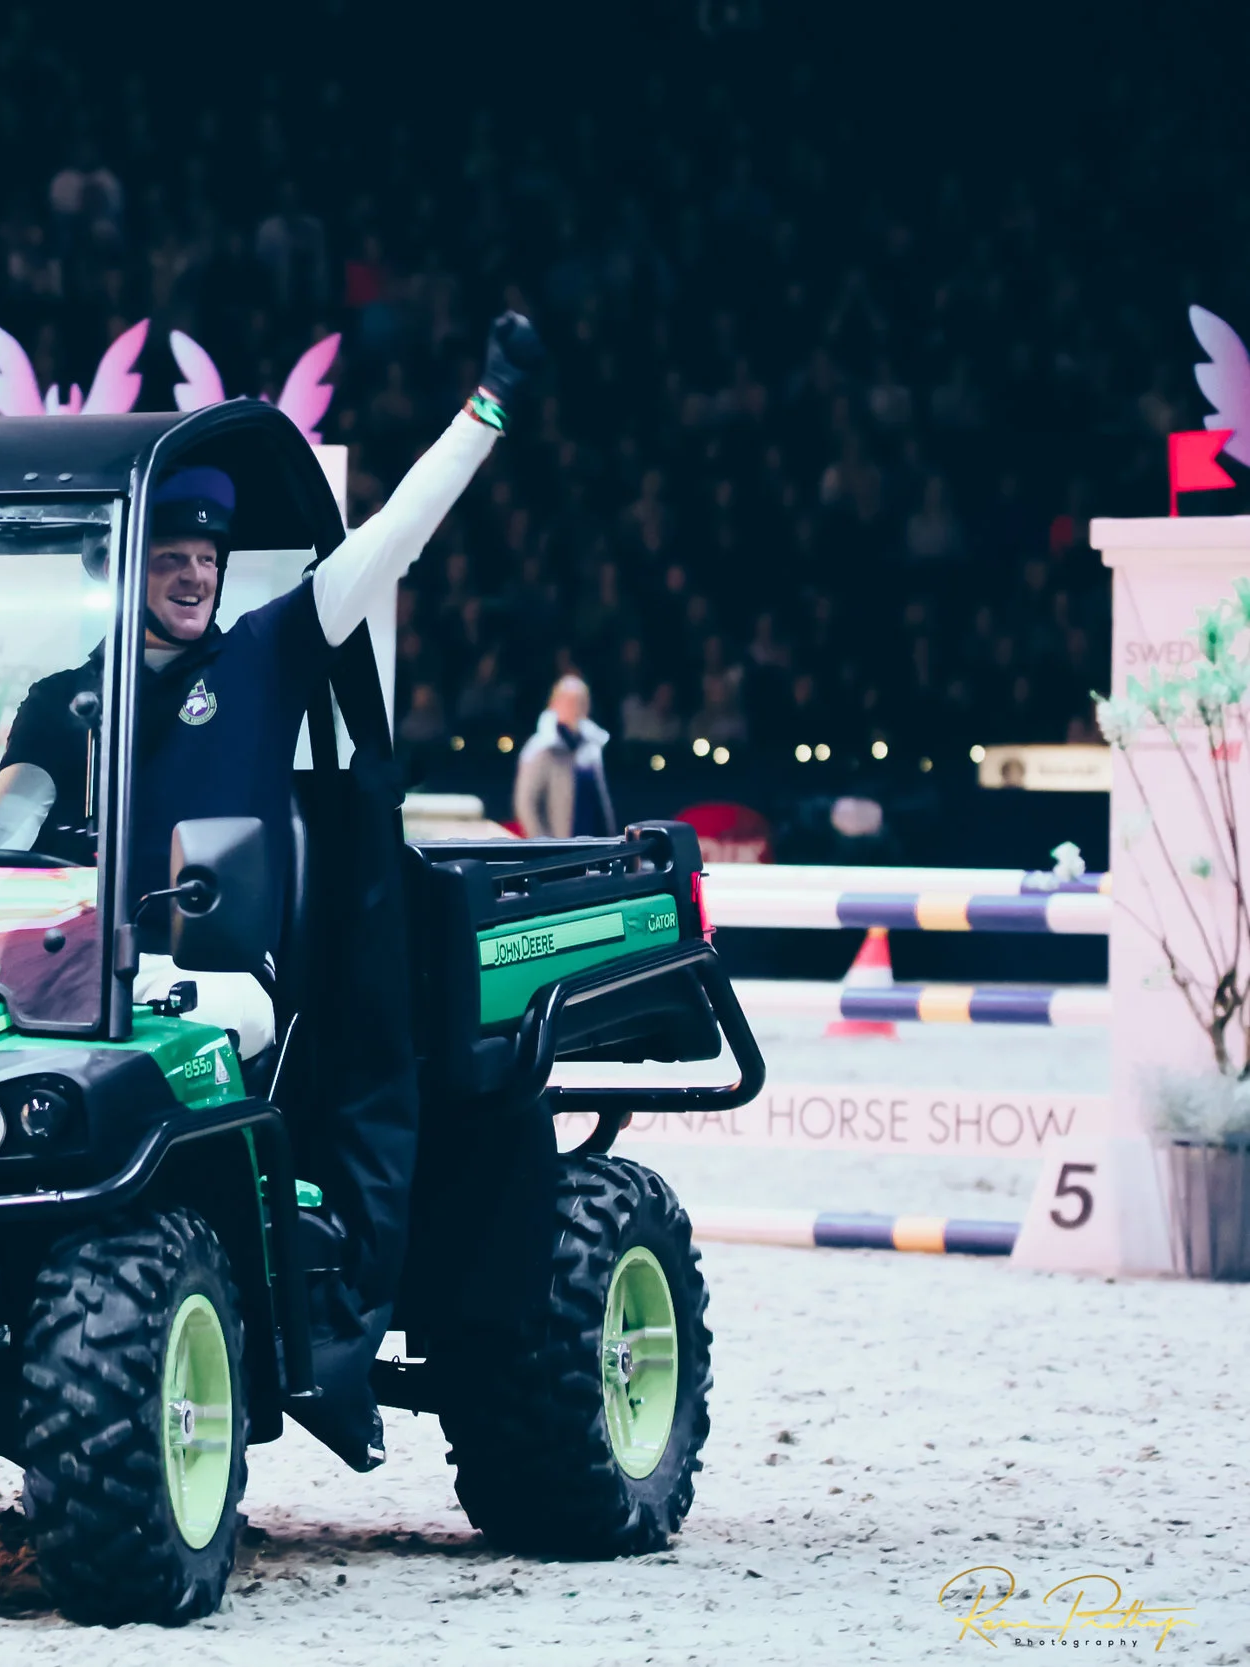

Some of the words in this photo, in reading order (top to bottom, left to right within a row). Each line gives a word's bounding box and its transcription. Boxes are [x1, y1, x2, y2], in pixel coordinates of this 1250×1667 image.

[648, 912, 676, 931] GATOR
[494, 940, 521, 964] JOHN
[521, 934, 556, 958] DEERE
[767, 1096, 909, 1142] HORSE
[928, 1101, 1076, 1147] SHOW
[1049, 1162, 1097, 1231] 5
